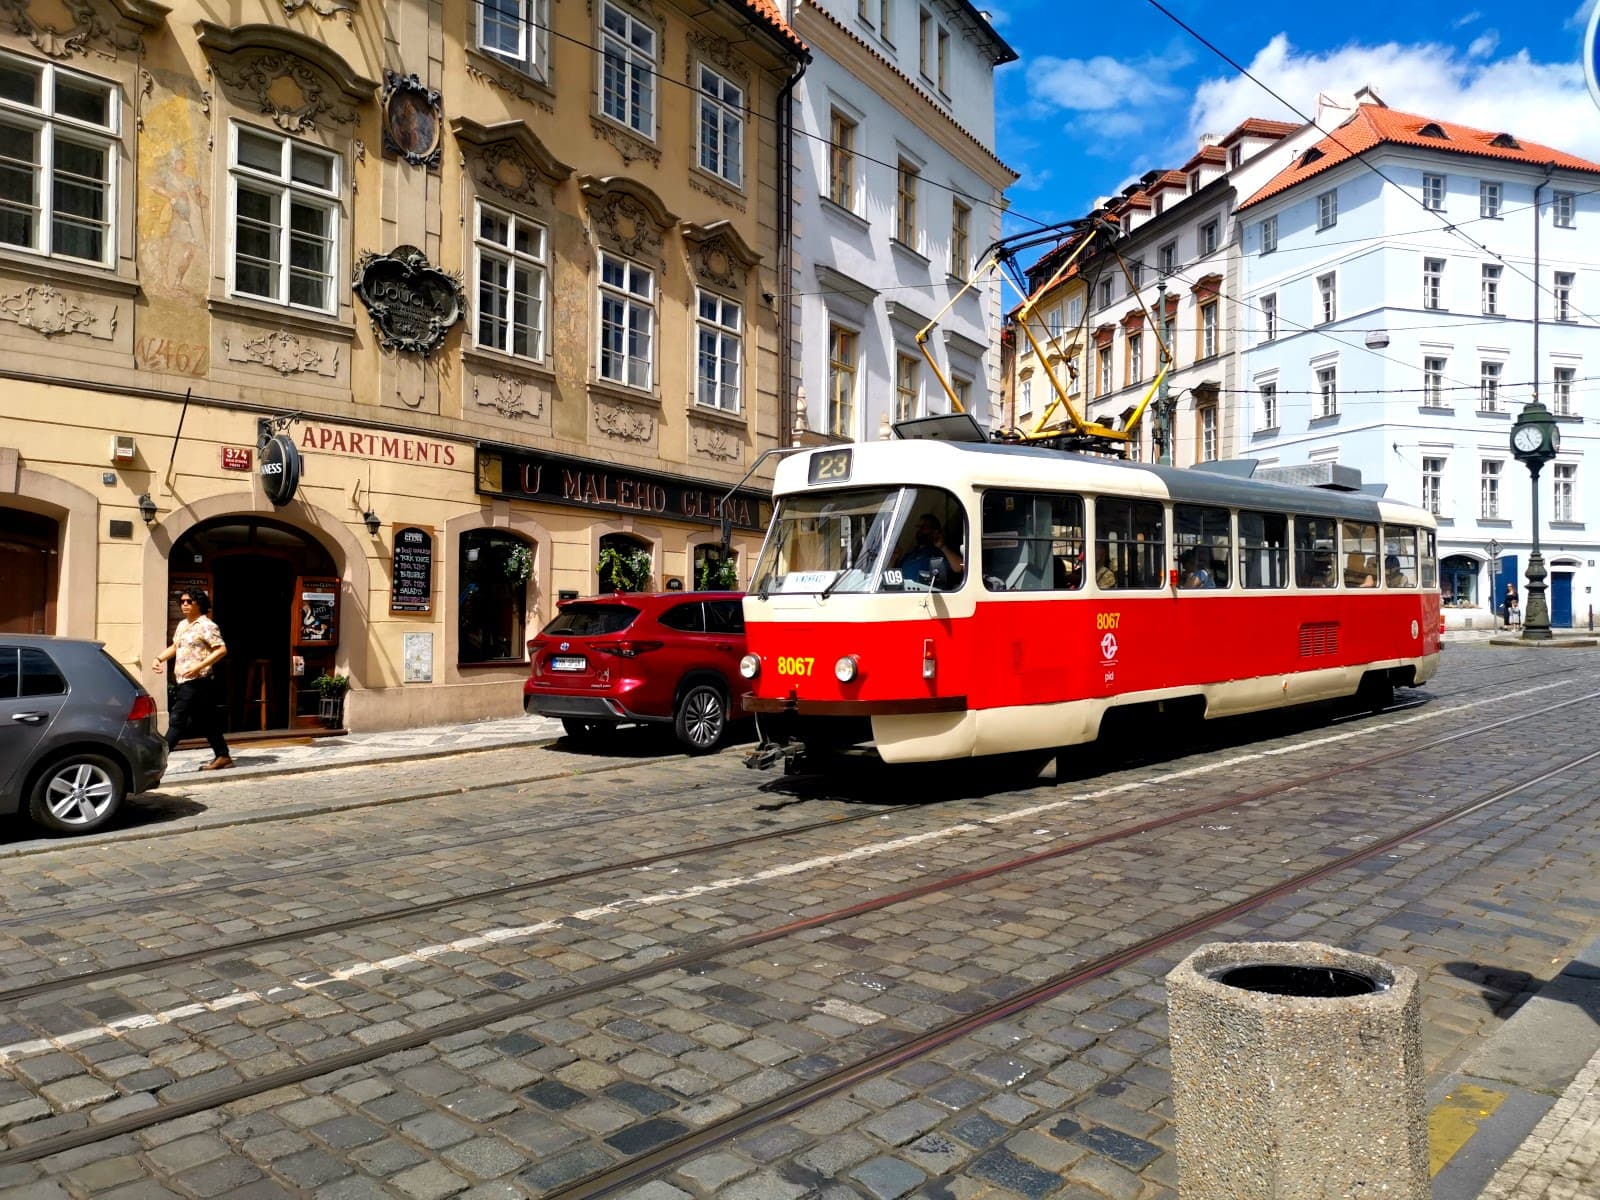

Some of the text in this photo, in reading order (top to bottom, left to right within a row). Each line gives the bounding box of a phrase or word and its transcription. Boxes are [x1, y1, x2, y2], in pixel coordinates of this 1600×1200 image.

[226, 448, 248, 460] 374
[301, 426, 456, 466] APARTMENTS
[818, 453, 848, 479] 23
[518, 463, 543, 494] U
[681, 489, 752, 527] GLENA
[884, 570, 903, 585] 109
[1096, 612, 1120, 630] 8067
[777, 656, 815, 677] 8067
